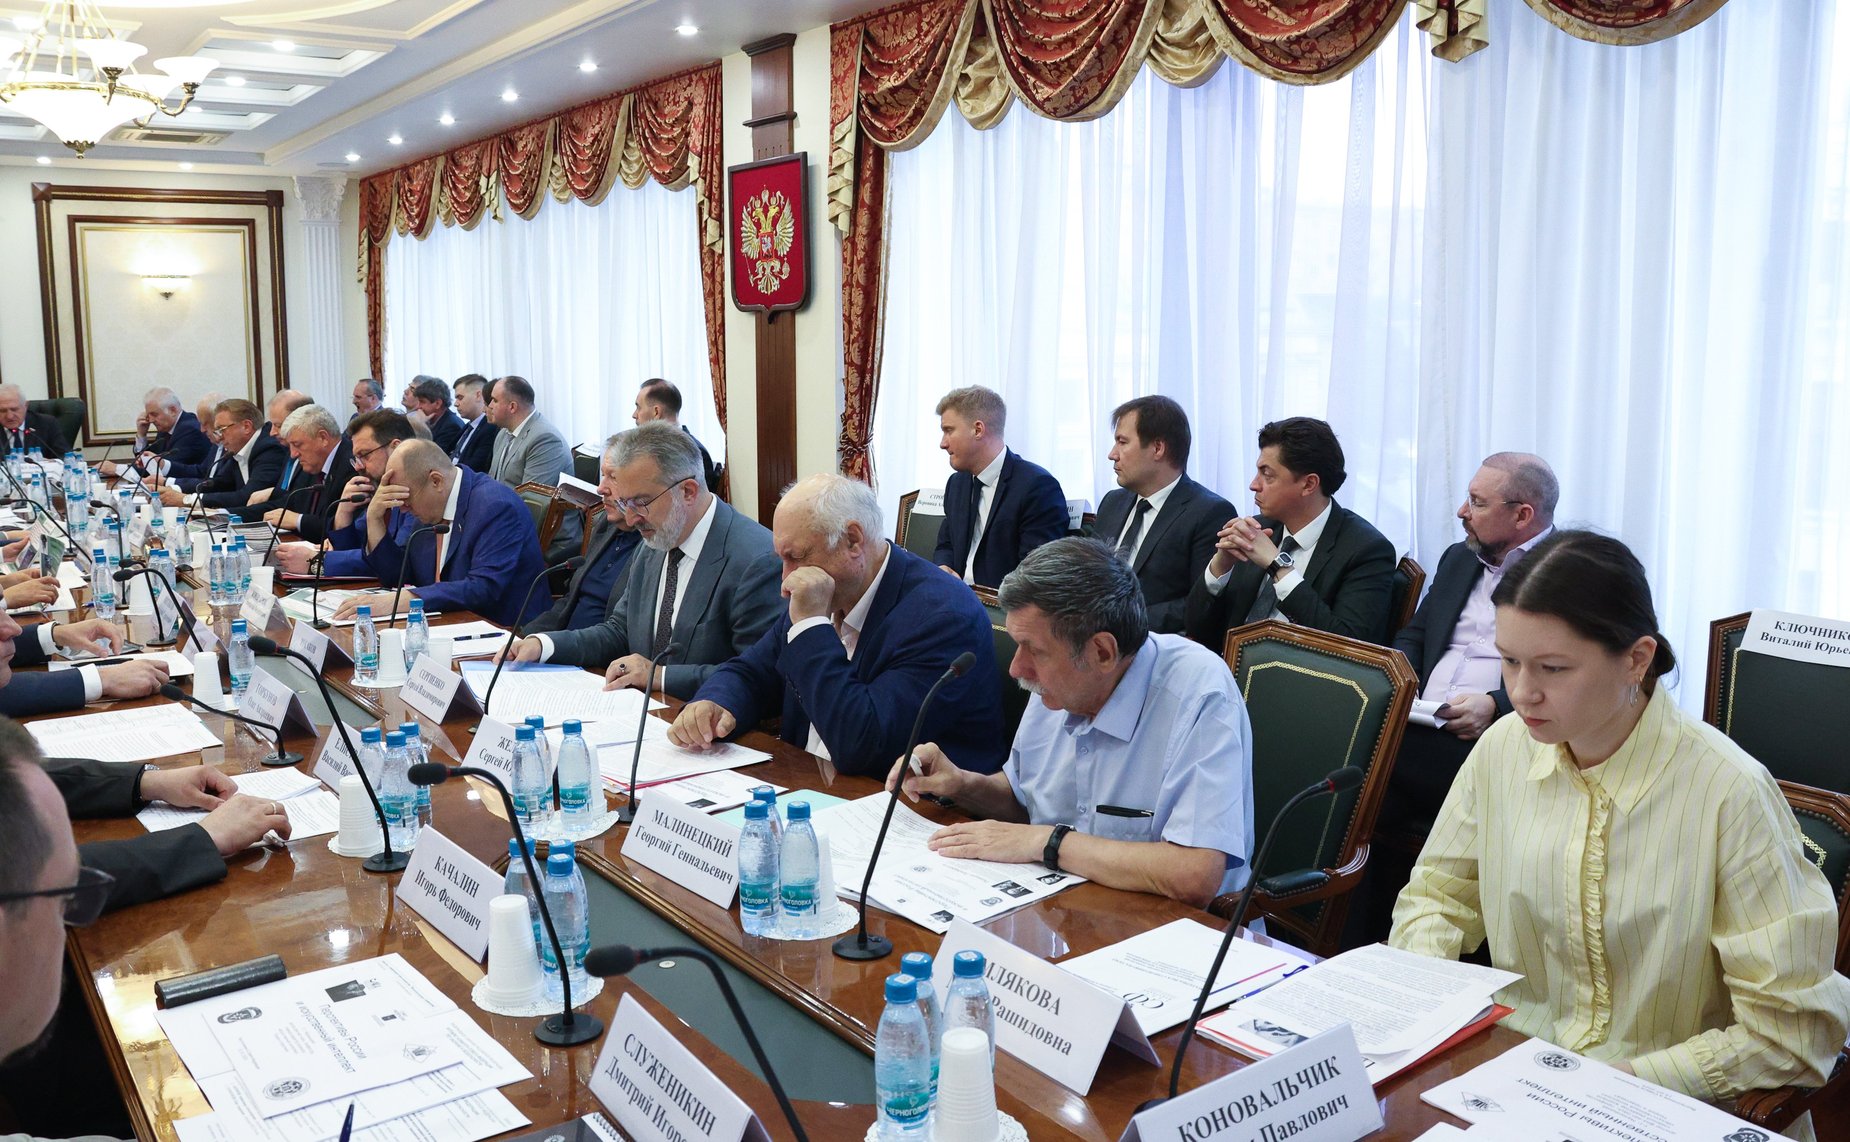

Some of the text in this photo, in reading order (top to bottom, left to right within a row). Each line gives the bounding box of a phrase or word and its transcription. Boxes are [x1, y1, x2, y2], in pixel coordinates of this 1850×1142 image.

[1760, 631, 1850, 655] Виталий Юрье
[1774, 620, 1850, 641] КЛЮЧНИК
[479, 747, 503, 768] Сергей
[635, 825, 734, 885] Георгий Геннадьевич
[651, 809, 733, 858] МАЛИНЕЦКИЙ
[414, 869, 482, 931] Игорь Федорович
[434, 856, 480, 898] КАЧАЛИН
[983, 957, 1062, 1016] ИЛЯКОВА
[992, 995, 1073, 1056] Рашидовна
[604, 1056, 654, 1116] Дмитрий
[623, 1033, 717, 1137] СЛУЖЕНИКИН
[1176, 1055, 1342, 1142] КОНОВАЛЬЧИК
[1258, 1093, 1350, 1142] Павлович
